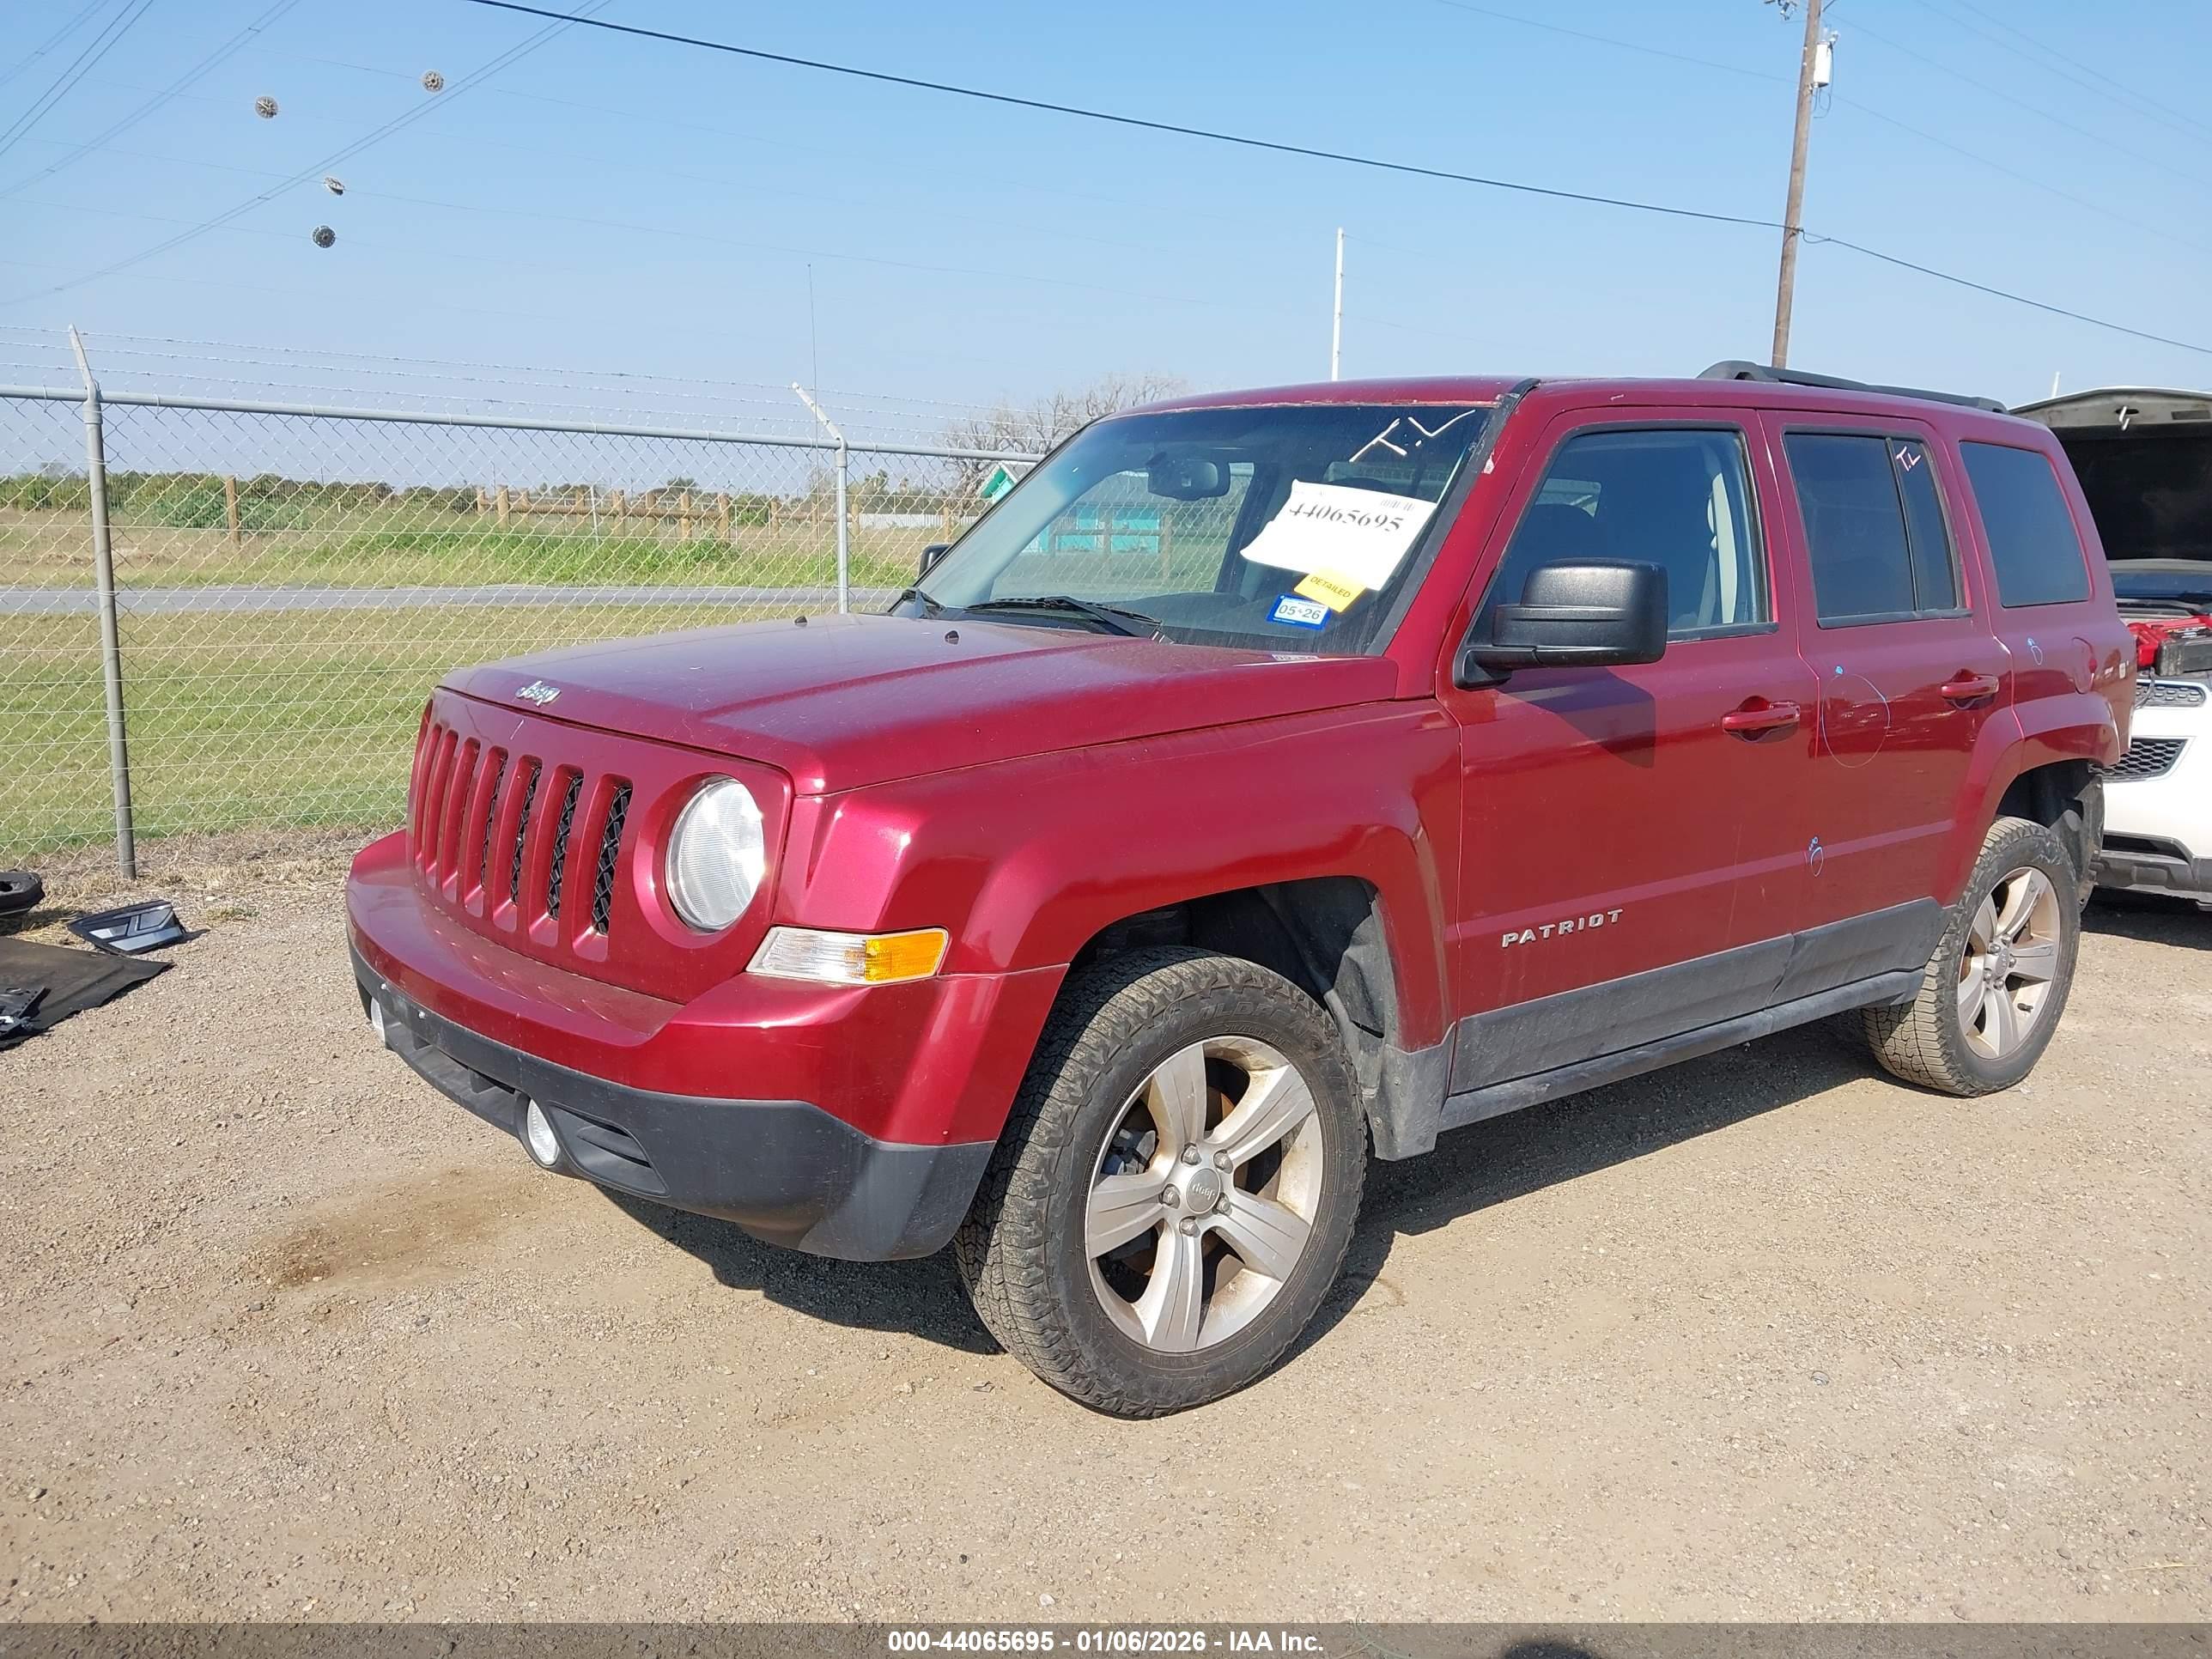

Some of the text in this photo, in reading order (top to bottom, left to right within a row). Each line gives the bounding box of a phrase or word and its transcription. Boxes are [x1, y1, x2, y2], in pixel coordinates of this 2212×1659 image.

[1290, 503, 1404, 532] 44065695
[1310, 576, 1351, 598] DETAILED
[515, 680, 562, 708] Jeep
[1501, 908, 1624, 948] PATRIOT
[1192, 1182, 1216, 1200] Jeep
